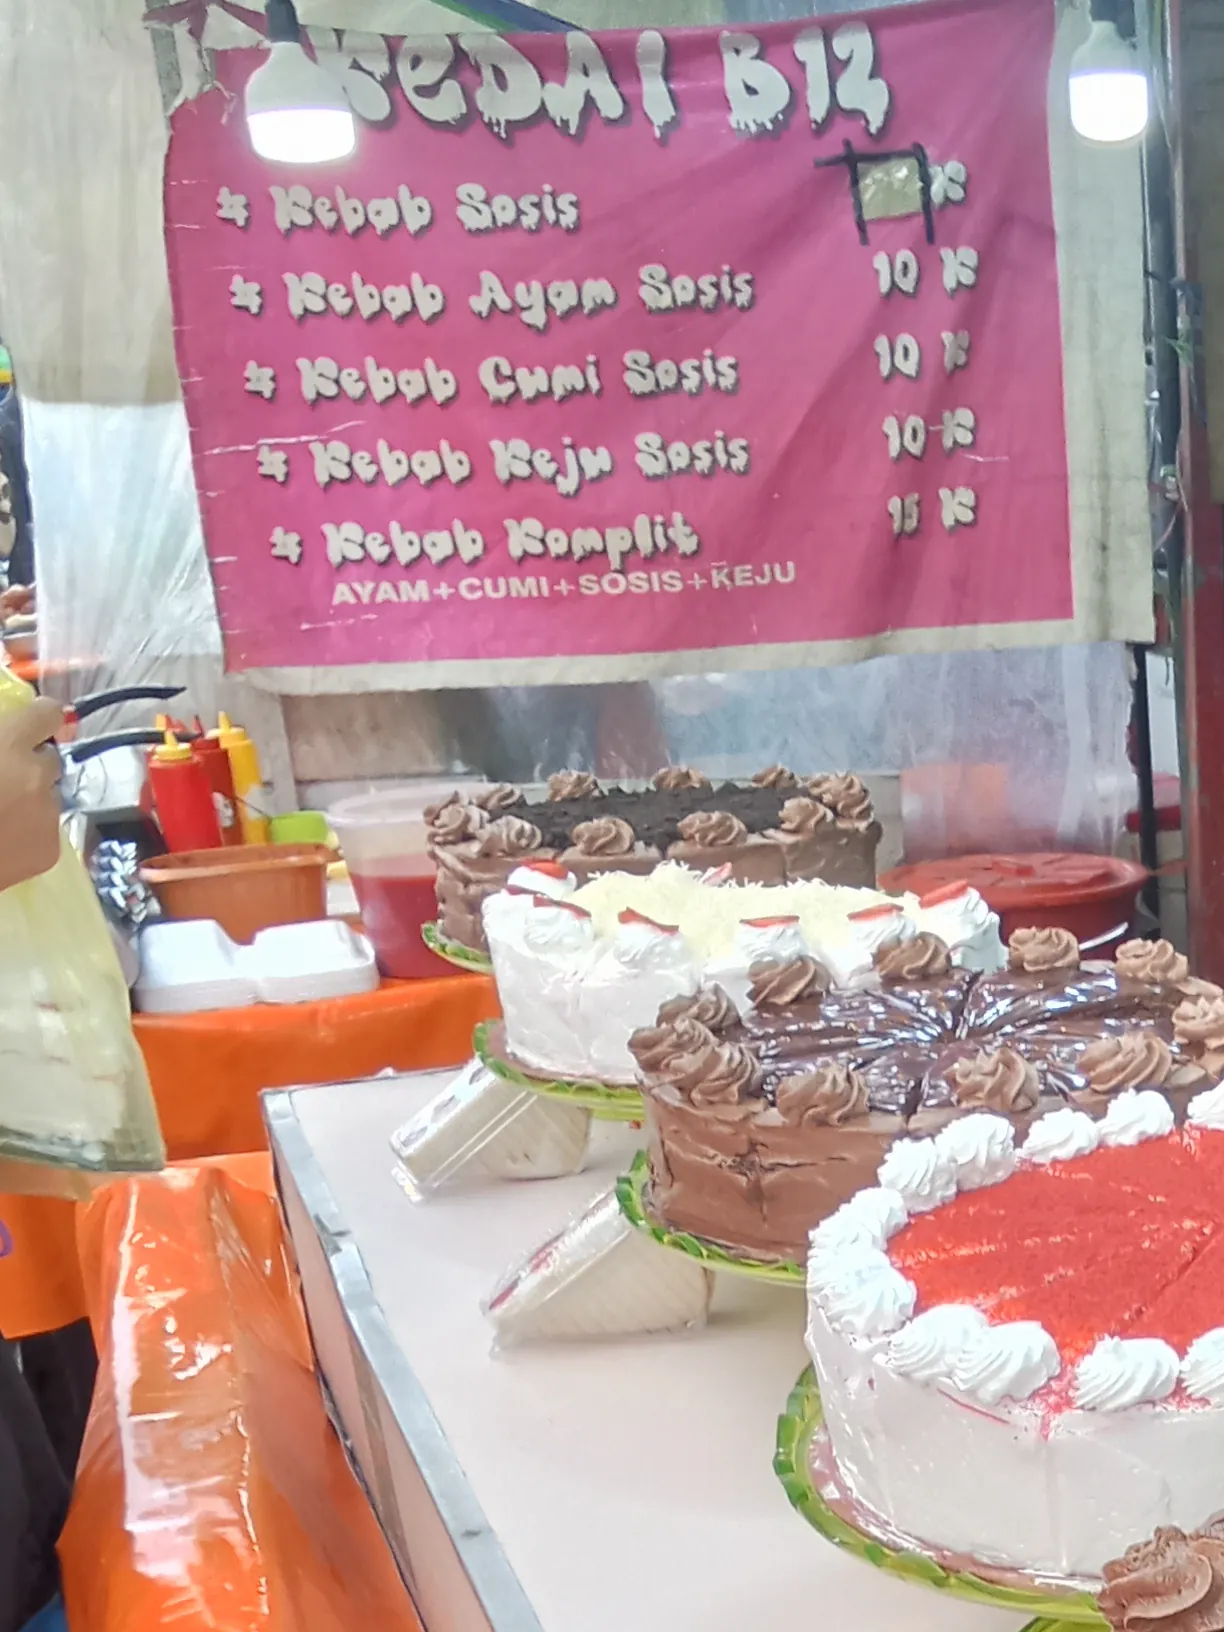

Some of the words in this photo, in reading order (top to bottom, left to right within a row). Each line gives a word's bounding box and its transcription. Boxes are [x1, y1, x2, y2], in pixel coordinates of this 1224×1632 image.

[718, 20, 890, 136] B12
[269, 183, 433, 236] Kebab
[456, 182, 580, 233] Sosis
[282, 271, 445, 322] Kebab
[469, 270, 618, 332] Ayam
[639, 264, 755, 312] Sosis
[872, 249, 920, 297] 10
[296, 355, 457, 405] Kebab
[478, 354, 602, 402] Cumi
[623, 348, 739, 394] Sosis
[874, 333, 921, 380] 10
[308, 438, 472, 488] Kebab
[490, 436, 613, 496] Keju
[635, 430, 751, 478] Sosis
[882, 414, 927, 461] 10
[322, 518, 485, 568] Kebab
[504, 511, 699, 571] Komplit
